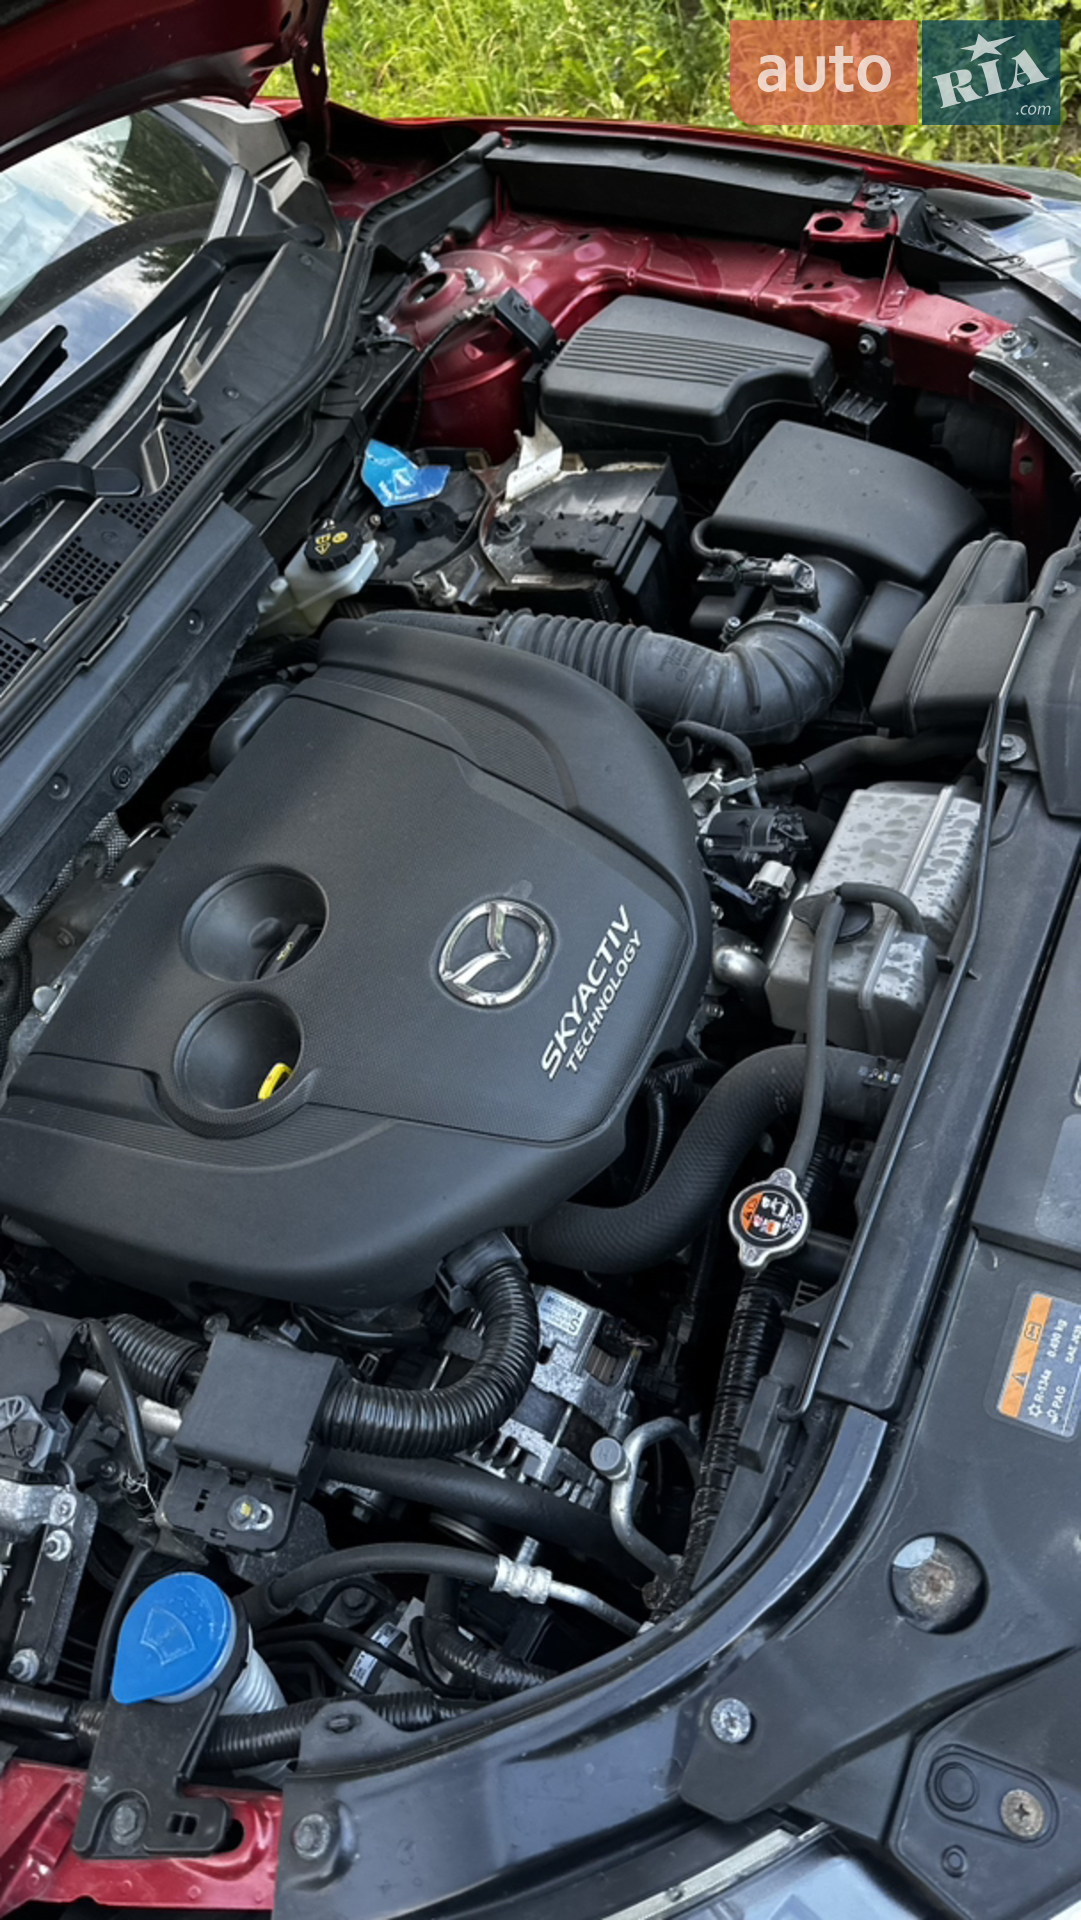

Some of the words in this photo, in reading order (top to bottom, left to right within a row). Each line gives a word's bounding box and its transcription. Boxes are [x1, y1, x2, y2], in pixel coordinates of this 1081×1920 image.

[541, 904, 632, 1080] SKYACTIV
[565, 930, 642, 1074] TECHNOLOGY
[1052, 1386, 1067, 1410] PAG
